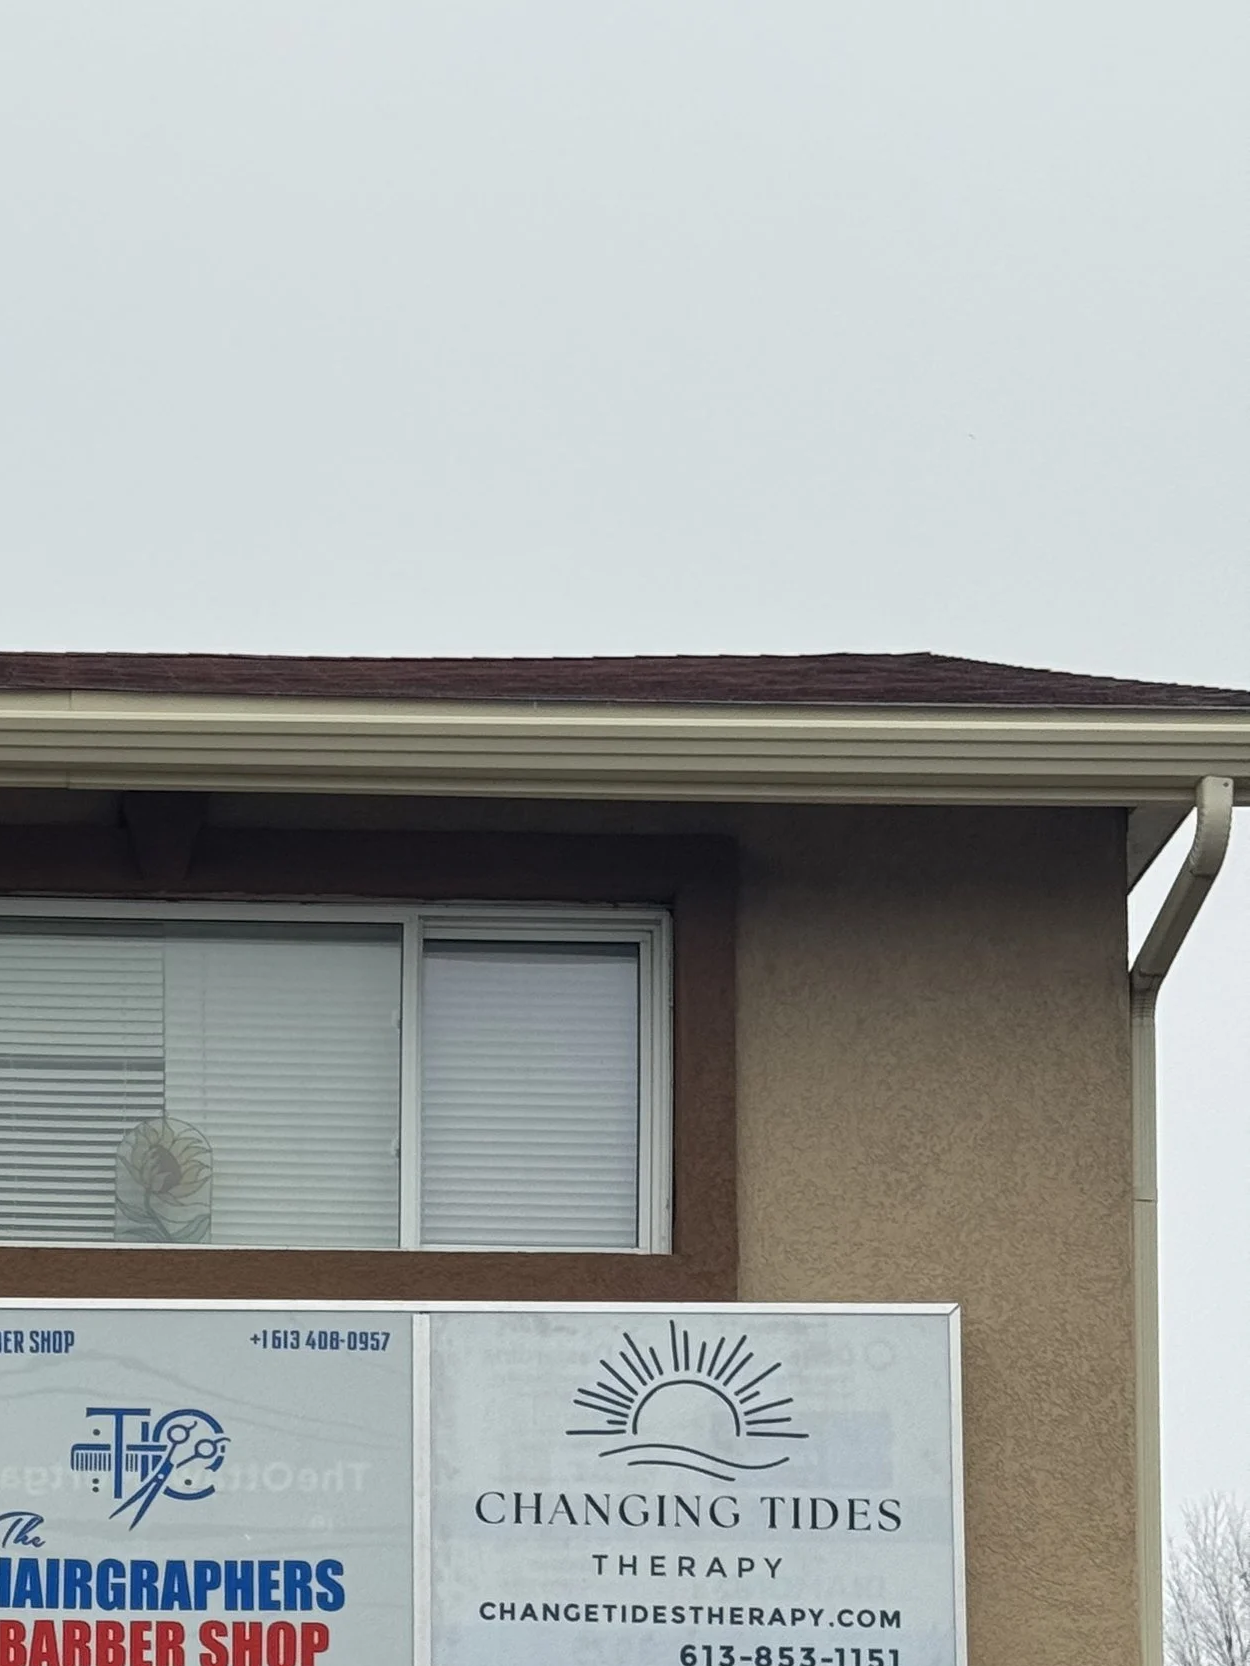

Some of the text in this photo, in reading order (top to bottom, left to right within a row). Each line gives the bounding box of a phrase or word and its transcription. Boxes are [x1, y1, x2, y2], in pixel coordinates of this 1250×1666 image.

[29, 1330, 75, 1355] SHOP
[271, 1330, 300, 1351] 613
[305, 1330, 391, 1352] 408-0957
[475, 1491, 902, 1532] CHANGING TIDES
[592, 1554, 784, 1579] THERAPY
[478, 1602, 902, 1629] CHANGETIDESTHERAPY.COM
